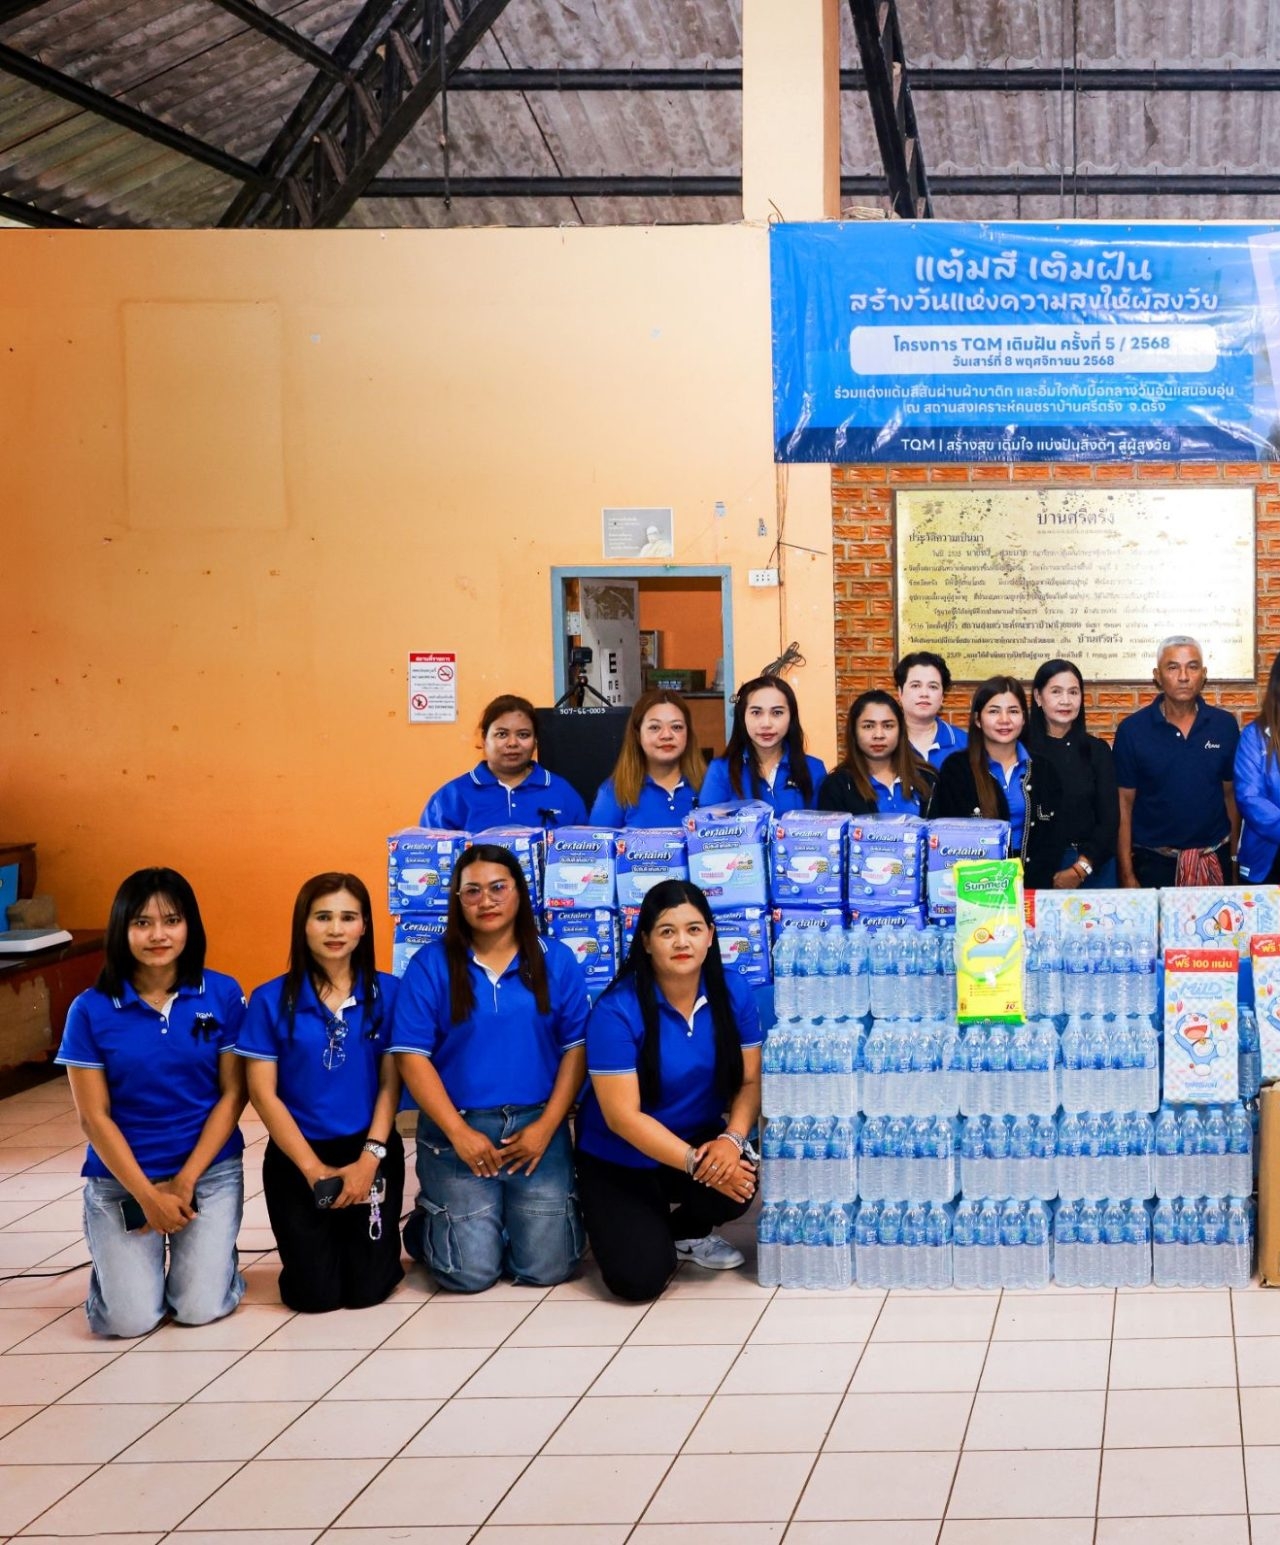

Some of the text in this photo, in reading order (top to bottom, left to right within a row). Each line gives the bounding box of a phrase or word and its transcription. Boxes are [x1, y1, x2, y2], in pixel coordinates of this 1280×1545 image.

[914, 248, 1152, 282] แต้มสี เติมฝัน
[894, 334, 958, 352] โครงการ
[961, 336, 1002, 353] TQM
[1006, 335, 1057, 352] เติมฝัน
[1060, 331, 1100, 352] ครั้งที่
[1105, 337, 1115, 350] 5
[1130, 336, 1171, 350] 2568
[952, 351, 1115, 369] วันเสาร์ที่ 8 พฤศจิกายน 2568
[906, 403, 920, 414] ณ
[1128, 399, 1167, 413] จ.ตรัง
[901, 439, 936, 453] TQM
[946, 436, 994, 454] สร้างสุข
[998, 437, 1033, 453] เติมใจ
[1118, 436, 1171, 456] สู่ผู้สูงวัย
[697, 826, 745, 840] Certainty
[554, 840, 602, 854] Certainty
[939, 846, 988, 859] Certainty
[626, 850, 675, 863] Certainty
[964, 878, 1010, 892] Sunmed
[783, 918, 829, 931] Certainty
[861, 915, 908, 928] Certainty
[1262, 942, 1278, 953] ฟรี
[1174, 957, 1191, 970] ฟรี
[1192, 959, 1210, 970] 100
[1211, 957, 1233, 970] แผ่น
